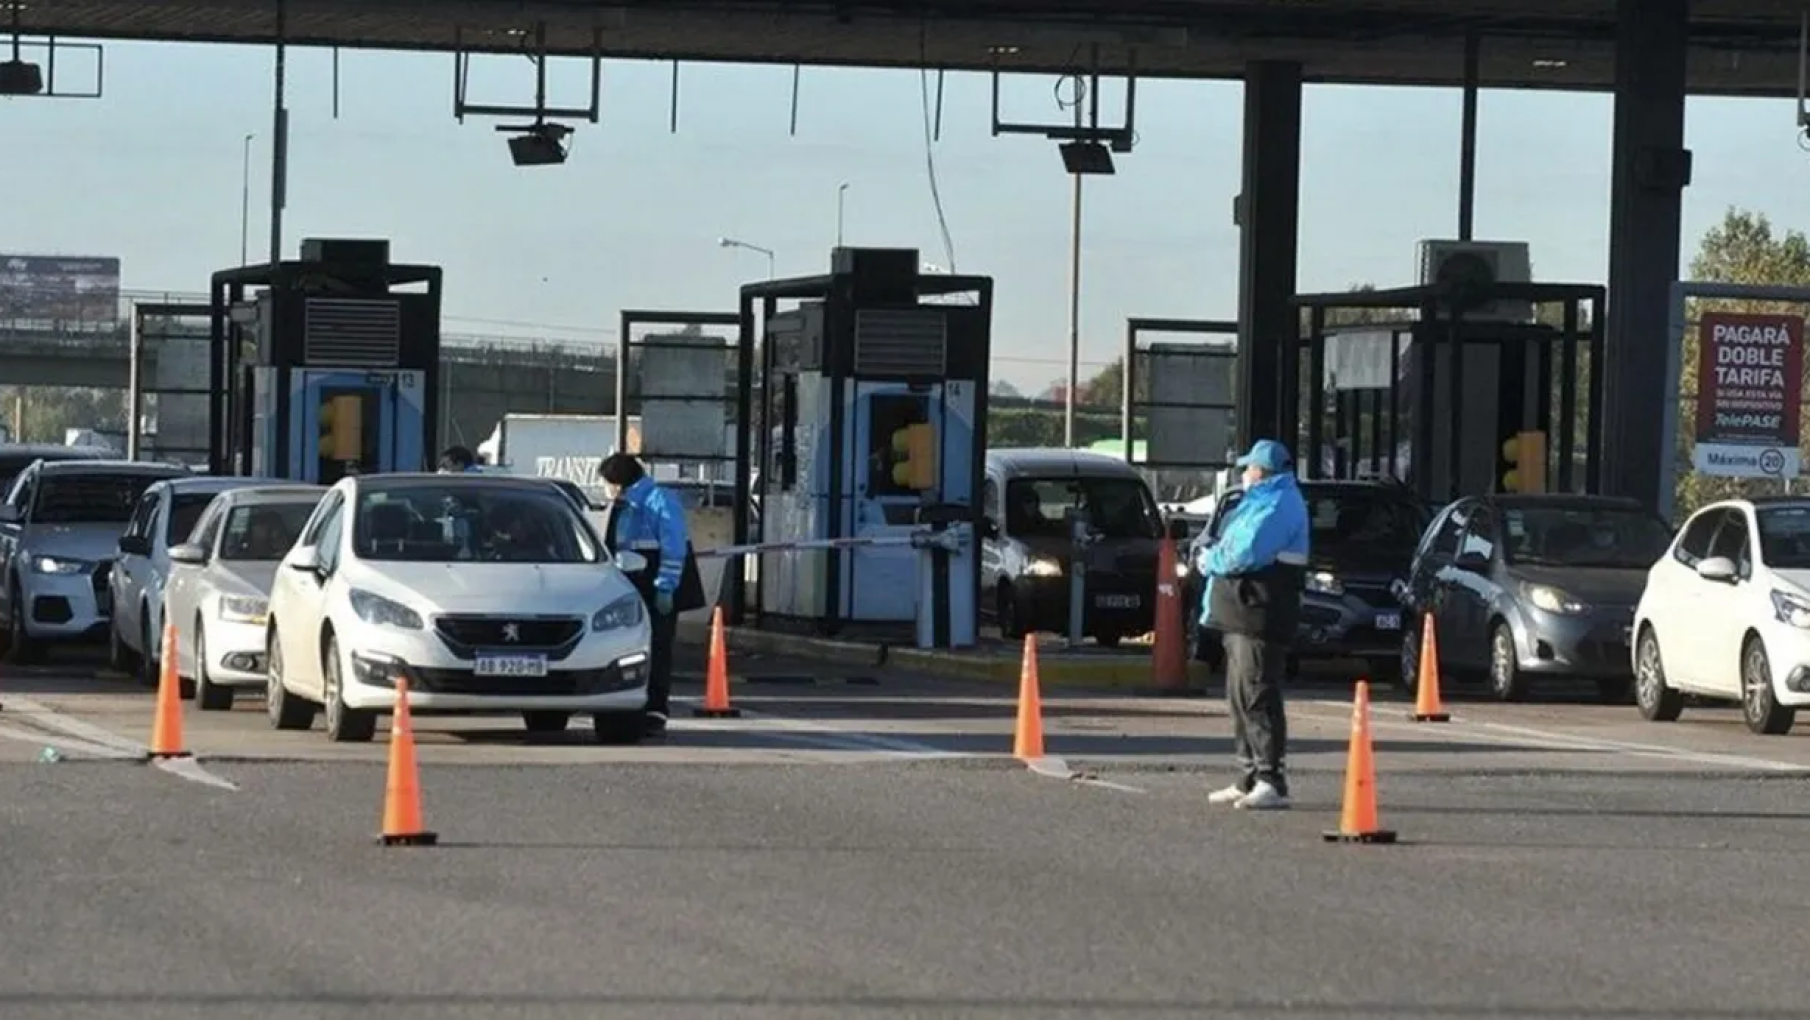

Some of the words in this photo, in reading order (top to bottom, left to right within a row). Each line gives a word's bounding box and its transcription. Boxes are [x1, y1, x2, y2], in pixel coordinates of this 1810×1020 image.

[1713, 323, 1790, 344] PAGARÁ
[1718, 347, 1784, 365] DOBLE
[1715, 367, 1784, 386] TARIFA
[1715, 413, 1781, 428] TelePASE
[1764, 455, 1780, 468] 20
[537, 456, 605, 487] TRANSIT
